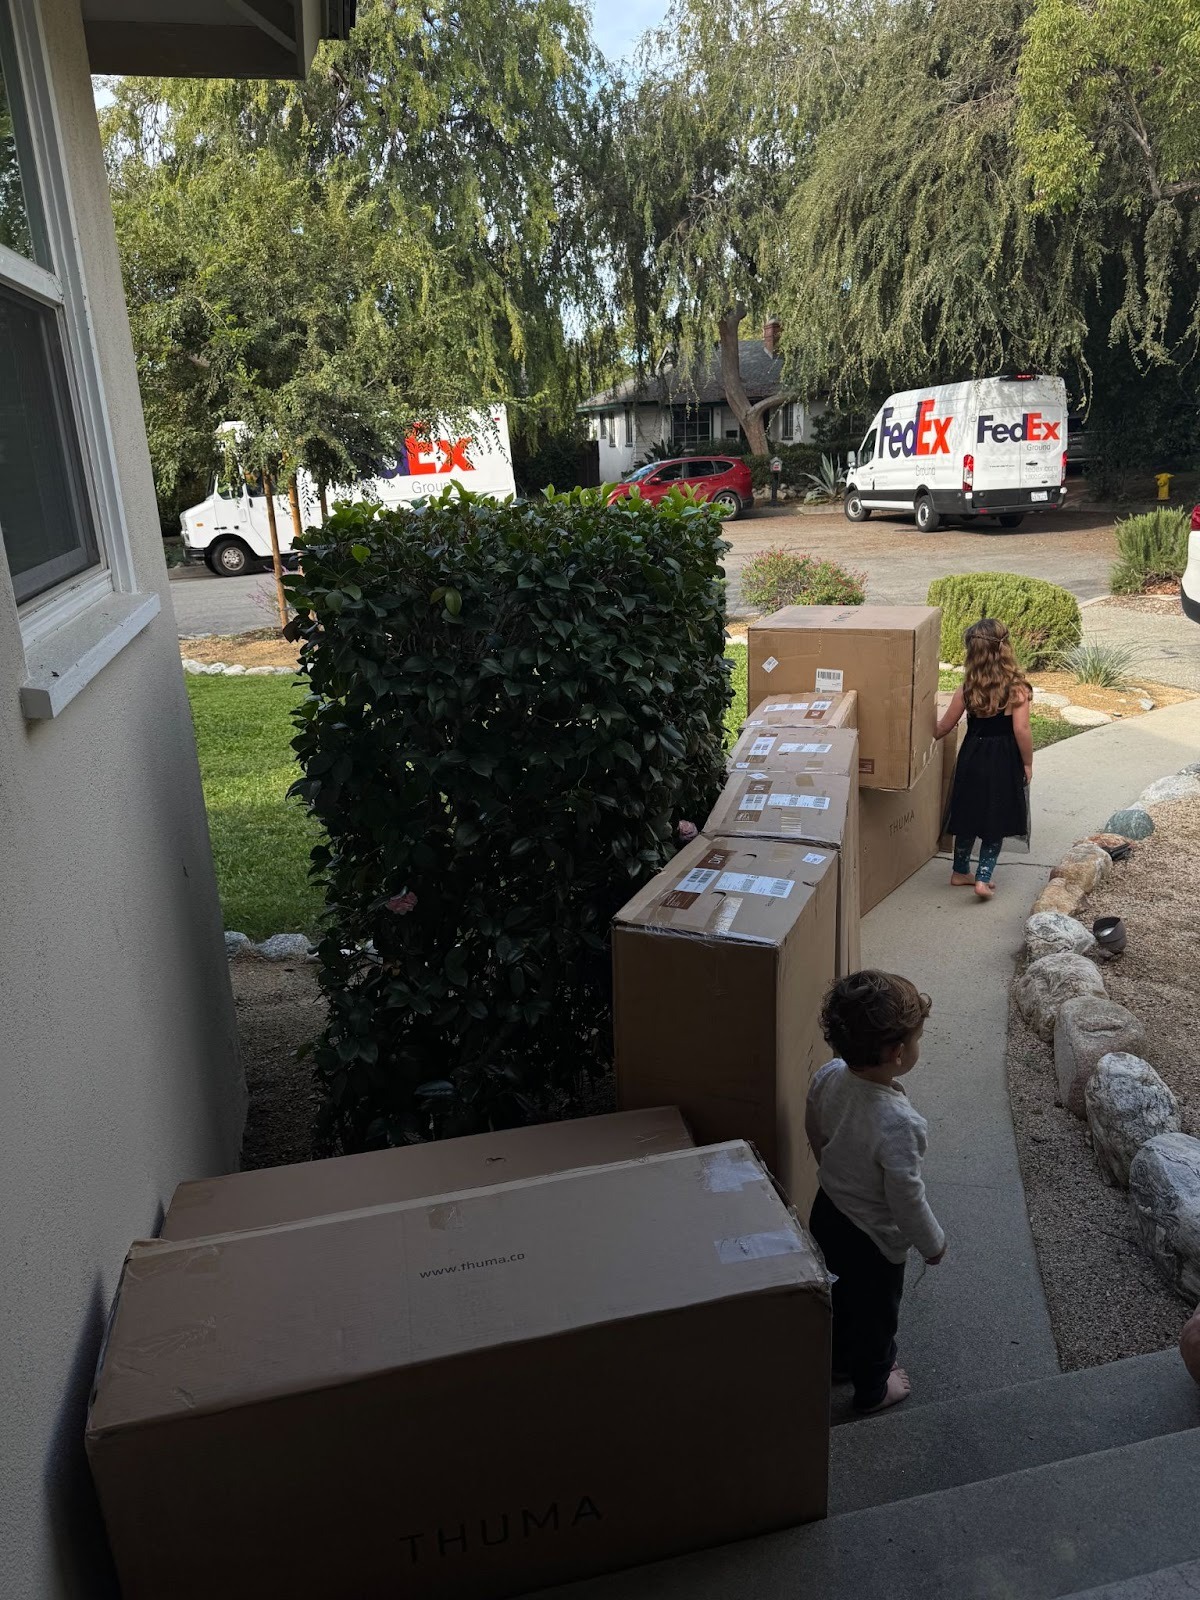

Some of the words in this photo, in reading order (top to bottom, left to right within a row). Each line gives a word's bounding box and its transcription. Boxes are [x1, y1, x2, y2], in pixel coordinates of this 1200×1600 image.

[878, 399, 953, 459] FedEx
[977, 412, 1061, 444] FedEx
[1026, 443, 1051, 451] Ground
[915, 464, 936, 476] Ground
[889, 809, 915, 837] THUMA
[420, 1253, 525, 1278] www.thuma.co
[399, 1495, 603, 1565] THUMA
